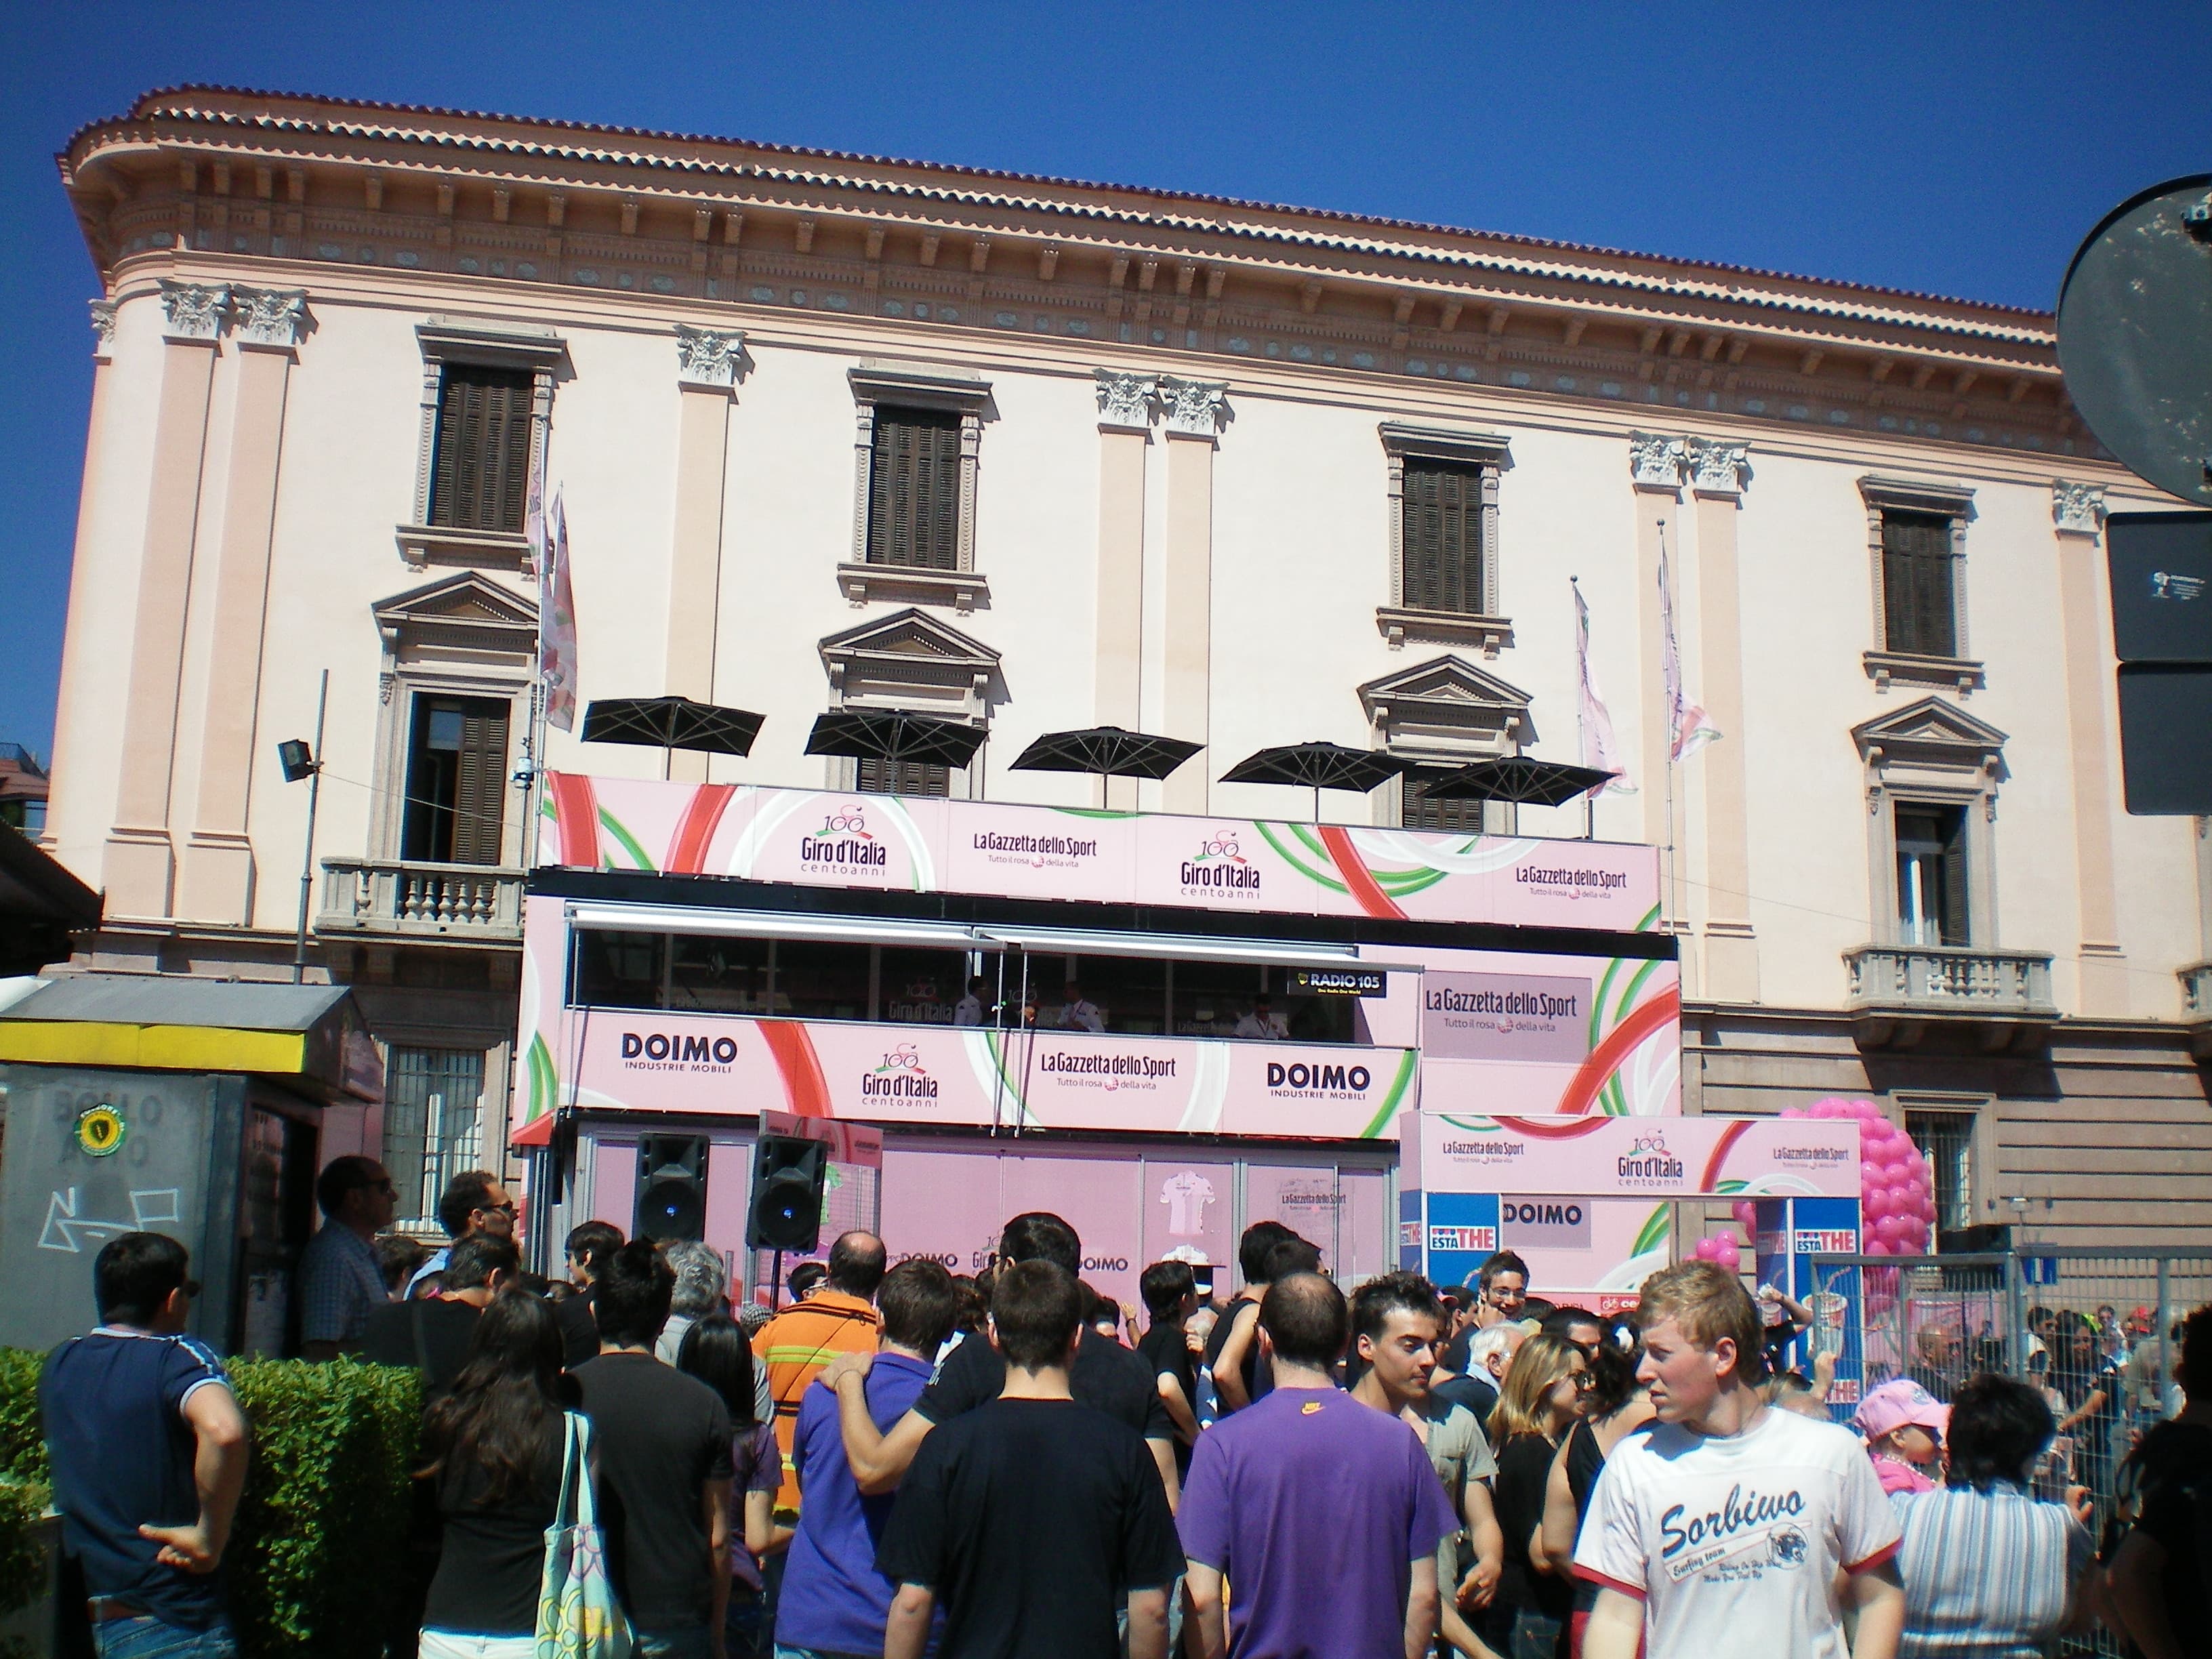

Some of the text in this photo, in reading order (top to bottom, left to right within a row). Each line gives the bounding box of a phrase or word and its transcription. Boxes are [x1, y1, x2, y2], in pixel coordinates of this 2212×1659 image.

[824, 815, 865, 833] 100
[802, 837, 886, 865] Giro d'Italia
[989, 832, 1036, 853] Gazzetta
[1038, 836, 1065, 855] dello
[1066, 838, 1097, 859] Sport
[1201, 840, 1240, 857] 100
[987, 855, 1007, 863] Tutto
[1046, 859, 1064, 867] della
[801, 863, 885, 876] centoanni
[1181, 862, 1260, 889] Giro d'Italia
[1530, 866, 1572, 885] Gazzetta
[1574, 869, 1598, 887] dello
[1599, 870, 1626, 890] Sport
[1181, 888, 1259, 900] centoanni
[1311, 973, 1380, 989] RADIO 105
[1443, 988, 1503, 1014] Gazzetta
[1506, 991, 1538, 1015] dello
[1539, 993, 1577, 1020] Sport
[1443, 1018, 1468, 1028] Tutto
[1476, 1021, 1495, 1029] rosa
[1516, 1021, 1538, 1031] della
[1539, 1023, 1556, 1032] vita
[621, 1033, 737, 1063] DOIMO
[625, 1061, 731, 1073] INDUSTRIE MOBILI
[882, 1053, 918, 1069] 100
[1057, 1052, 1109, 1074] Gazzetta
[1112, 1054, 1141, 1076] dello
[1142, 1056, 1176, 1080] Sport
[1057, 1078, 1078, 1087] Tutto
[1120, 1081, 1140, 1089] della
[1267, 1063, 1370, 1091] DOIMO
[863, 1073, 938, 1098] Giro d'Italia
[862, 1097, 937, 1108] centoanni
[1271, 1089, 1366, 1101] INDUSTRIE MOBILI
[1634, 1138, 1665, 1151] 100
[1618, 1157, 1683, 1177] Giro d'Italia
[1618, 1179, 1683, 1187] centoanni
[1503, 1204, 1582, 1225] DOIMO
[1079, 1257, 1128, 1271] OIMO
